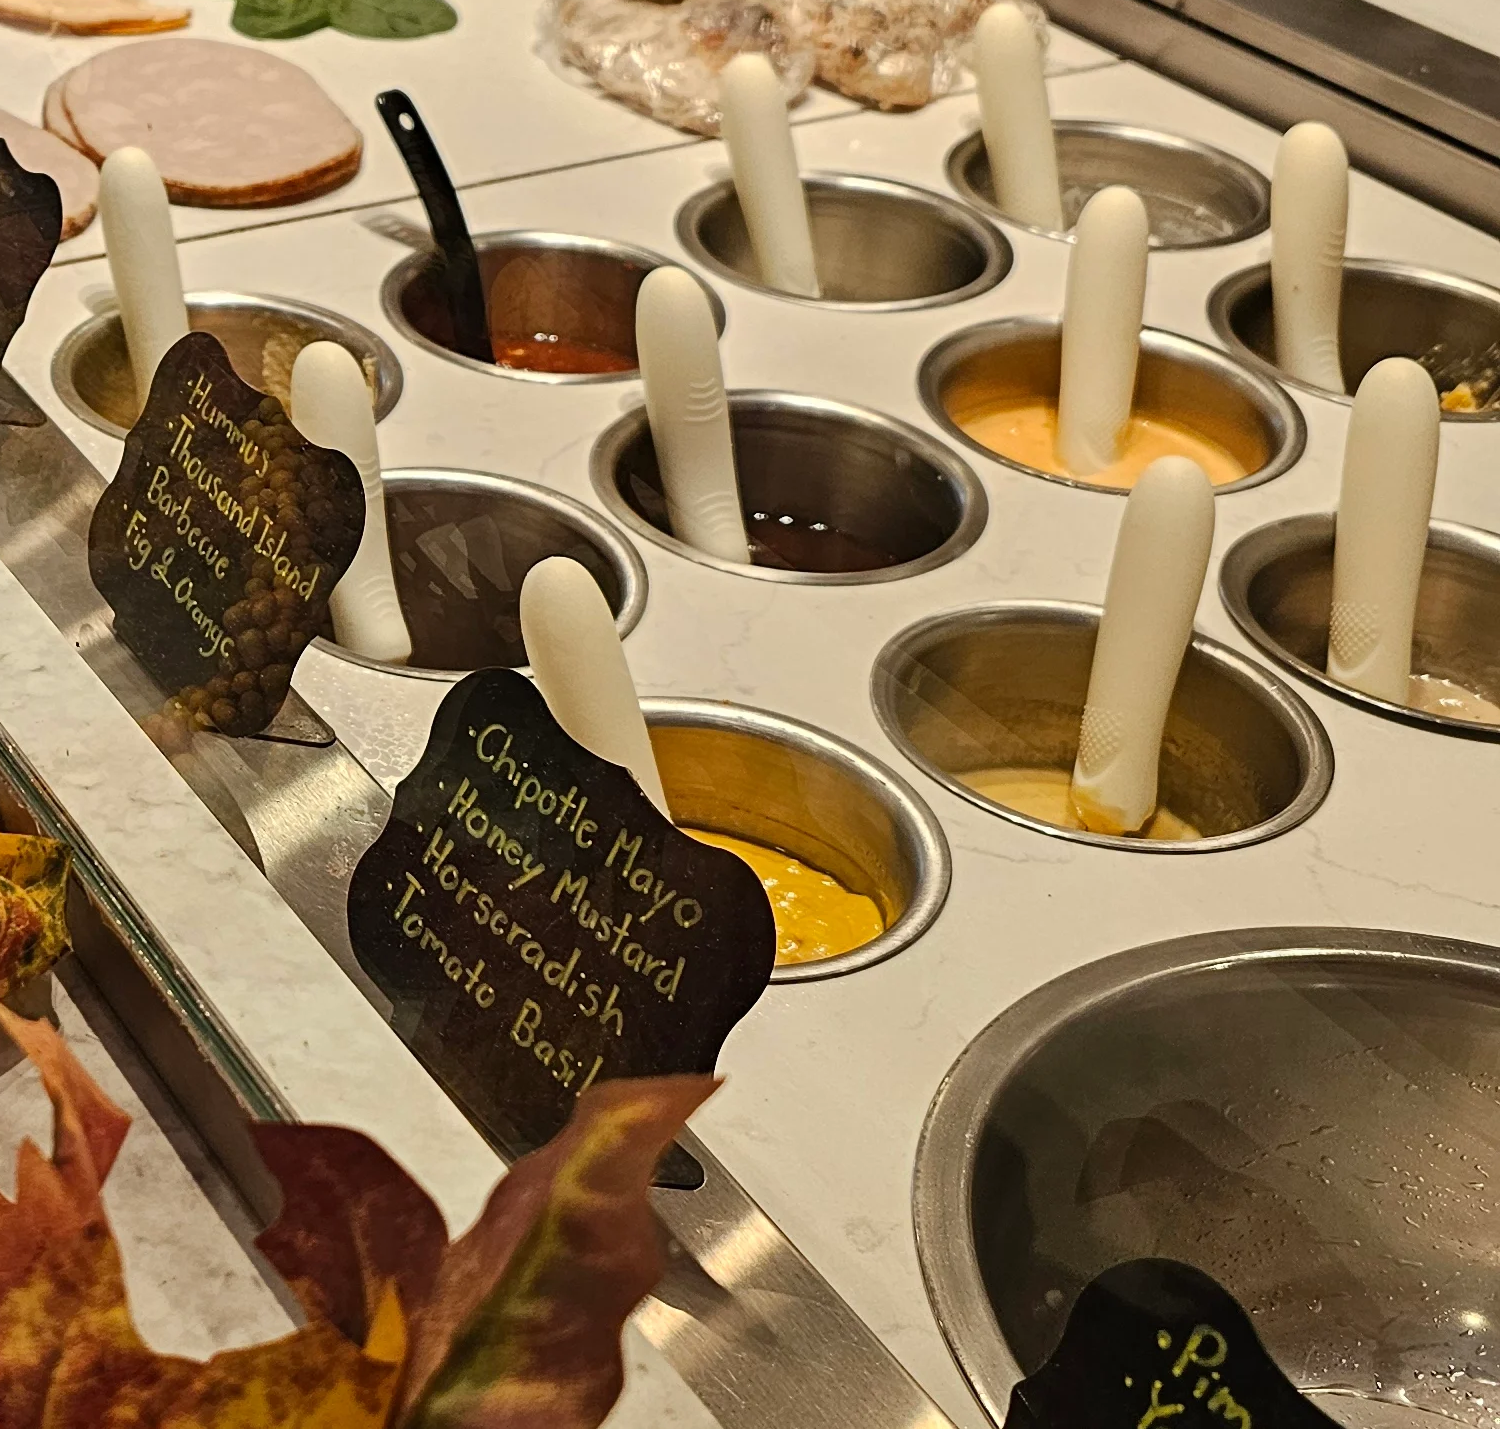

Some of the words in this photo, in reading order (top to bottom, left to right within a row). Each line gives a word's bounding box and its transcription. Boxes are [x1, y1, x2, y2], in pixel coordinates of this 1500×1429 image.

[147, 465, 230, 580] Barbecue
[169, 414, 254, 538] Thousand
[254, 514, 320, 602] Island
[187, 373, 270, 478] Hummus
[125, 511, 152, 571] Fig
[174, 575, 235, 658] Orange
[447, 776, 546, 891] Honey
[549, 868, 686, 1002] Mustard
[475, 723, 600, 849] Chipotle
[604, 828, 703, 929] Mayo
[393, 871, 496, 1009] Tomato
[510, 997, 604, 1097] Basil
[422, 827, 623, 1036] Horseradish
